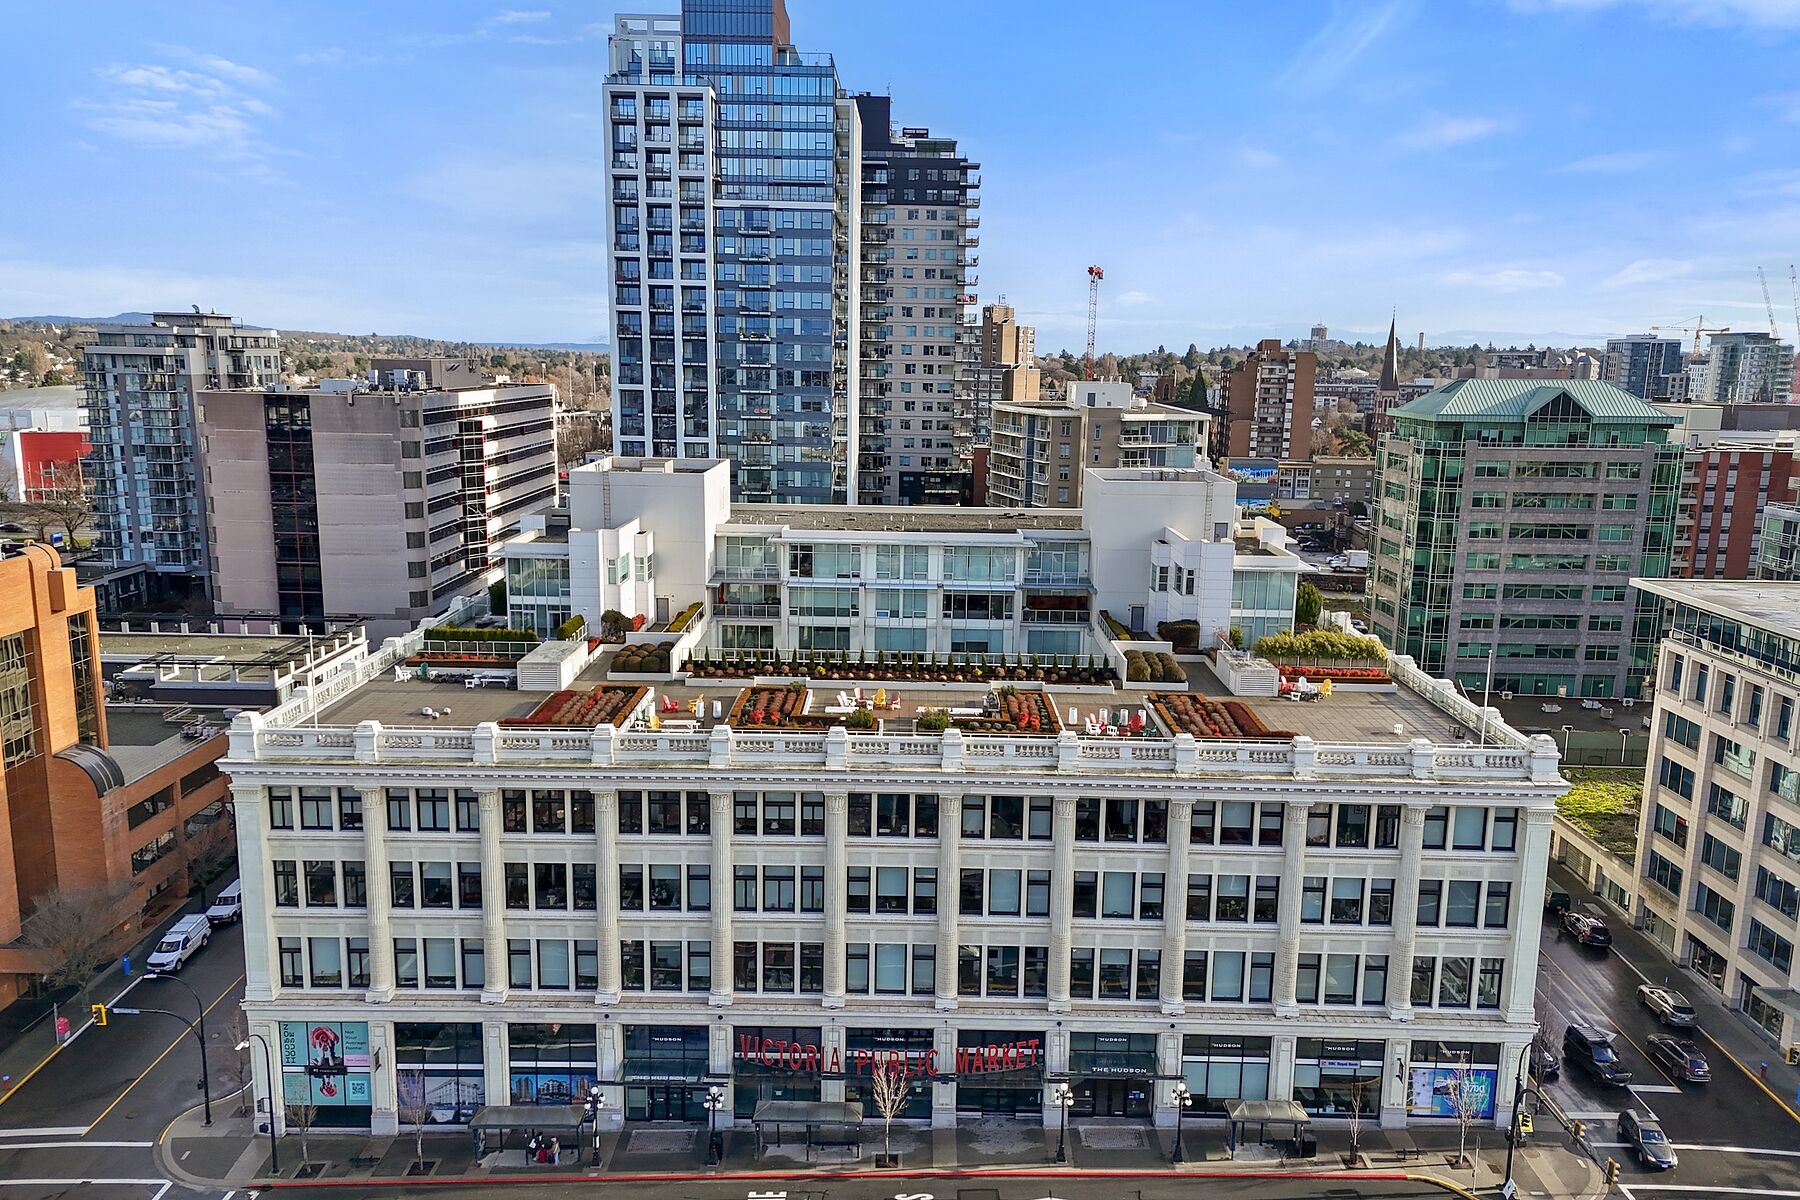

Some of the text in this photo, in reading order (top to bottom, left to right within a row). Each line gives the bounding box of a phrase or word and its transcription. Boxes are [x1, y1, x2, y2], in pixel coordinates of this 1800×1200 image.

[283, 1024, 291, 1064] HUDSON
[739, 1034, 1039, 1077] VICTORIA PUBLIC MARKET
